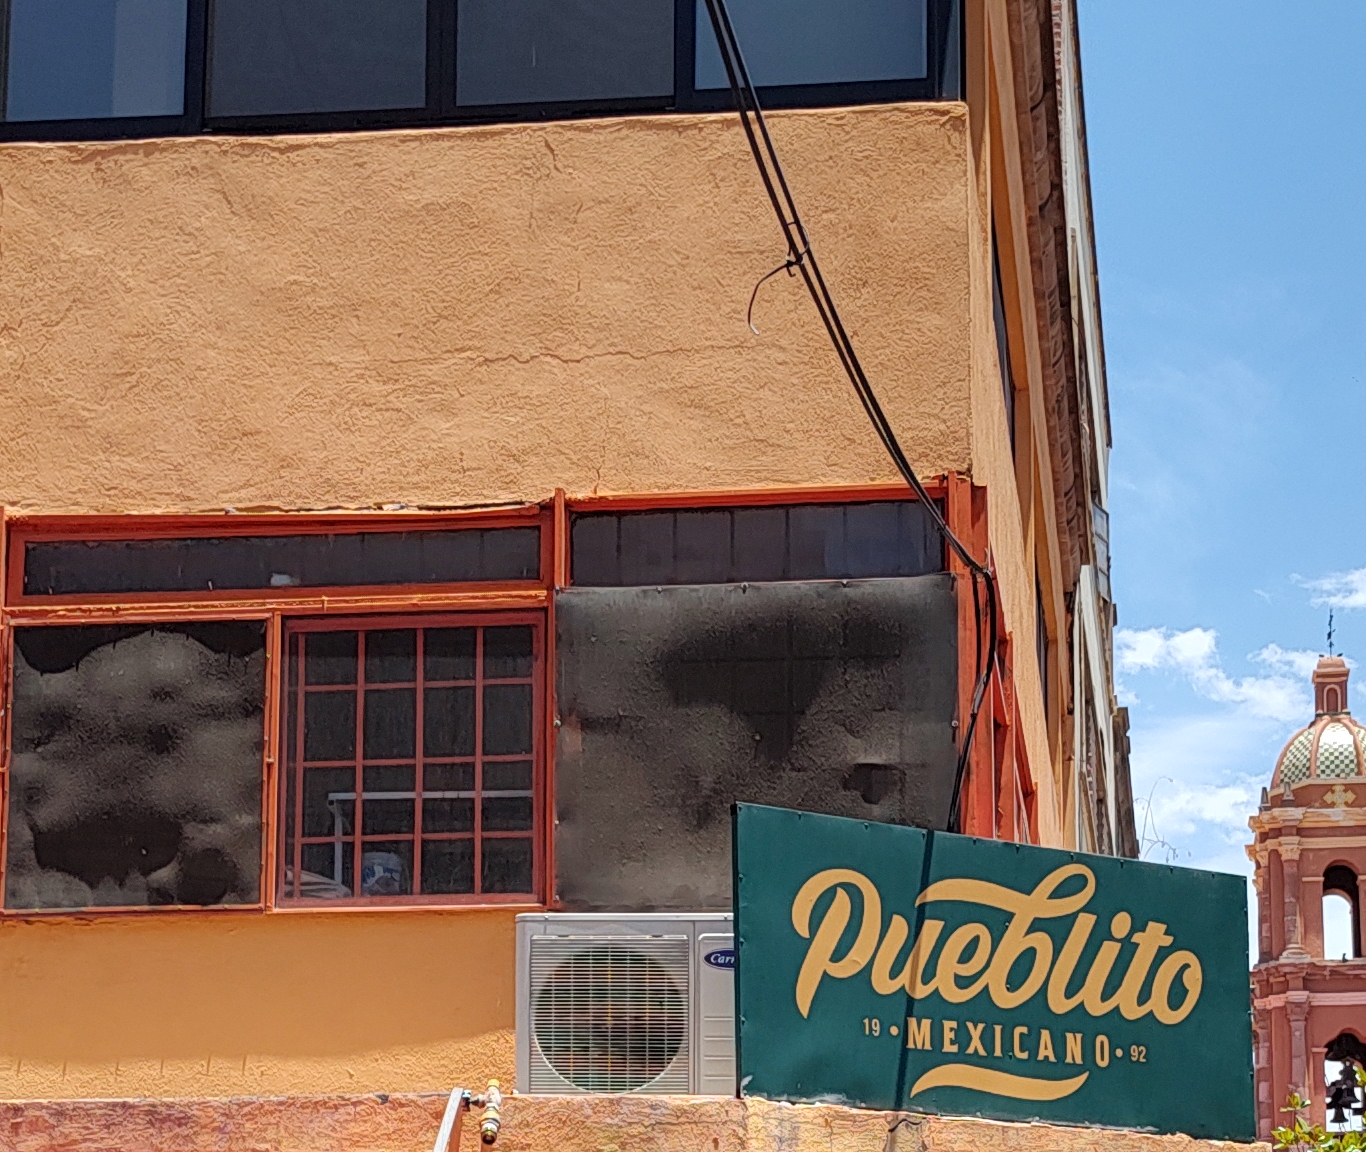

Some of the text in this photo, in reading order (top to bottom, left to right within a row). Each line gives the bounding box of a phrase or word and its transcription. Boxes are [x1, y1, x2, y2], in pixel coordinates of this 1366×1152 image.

[791, 864, 1203, 1025] Pueblito
[863, 1017, 1147, 1069] 19 MEXICANO 92
